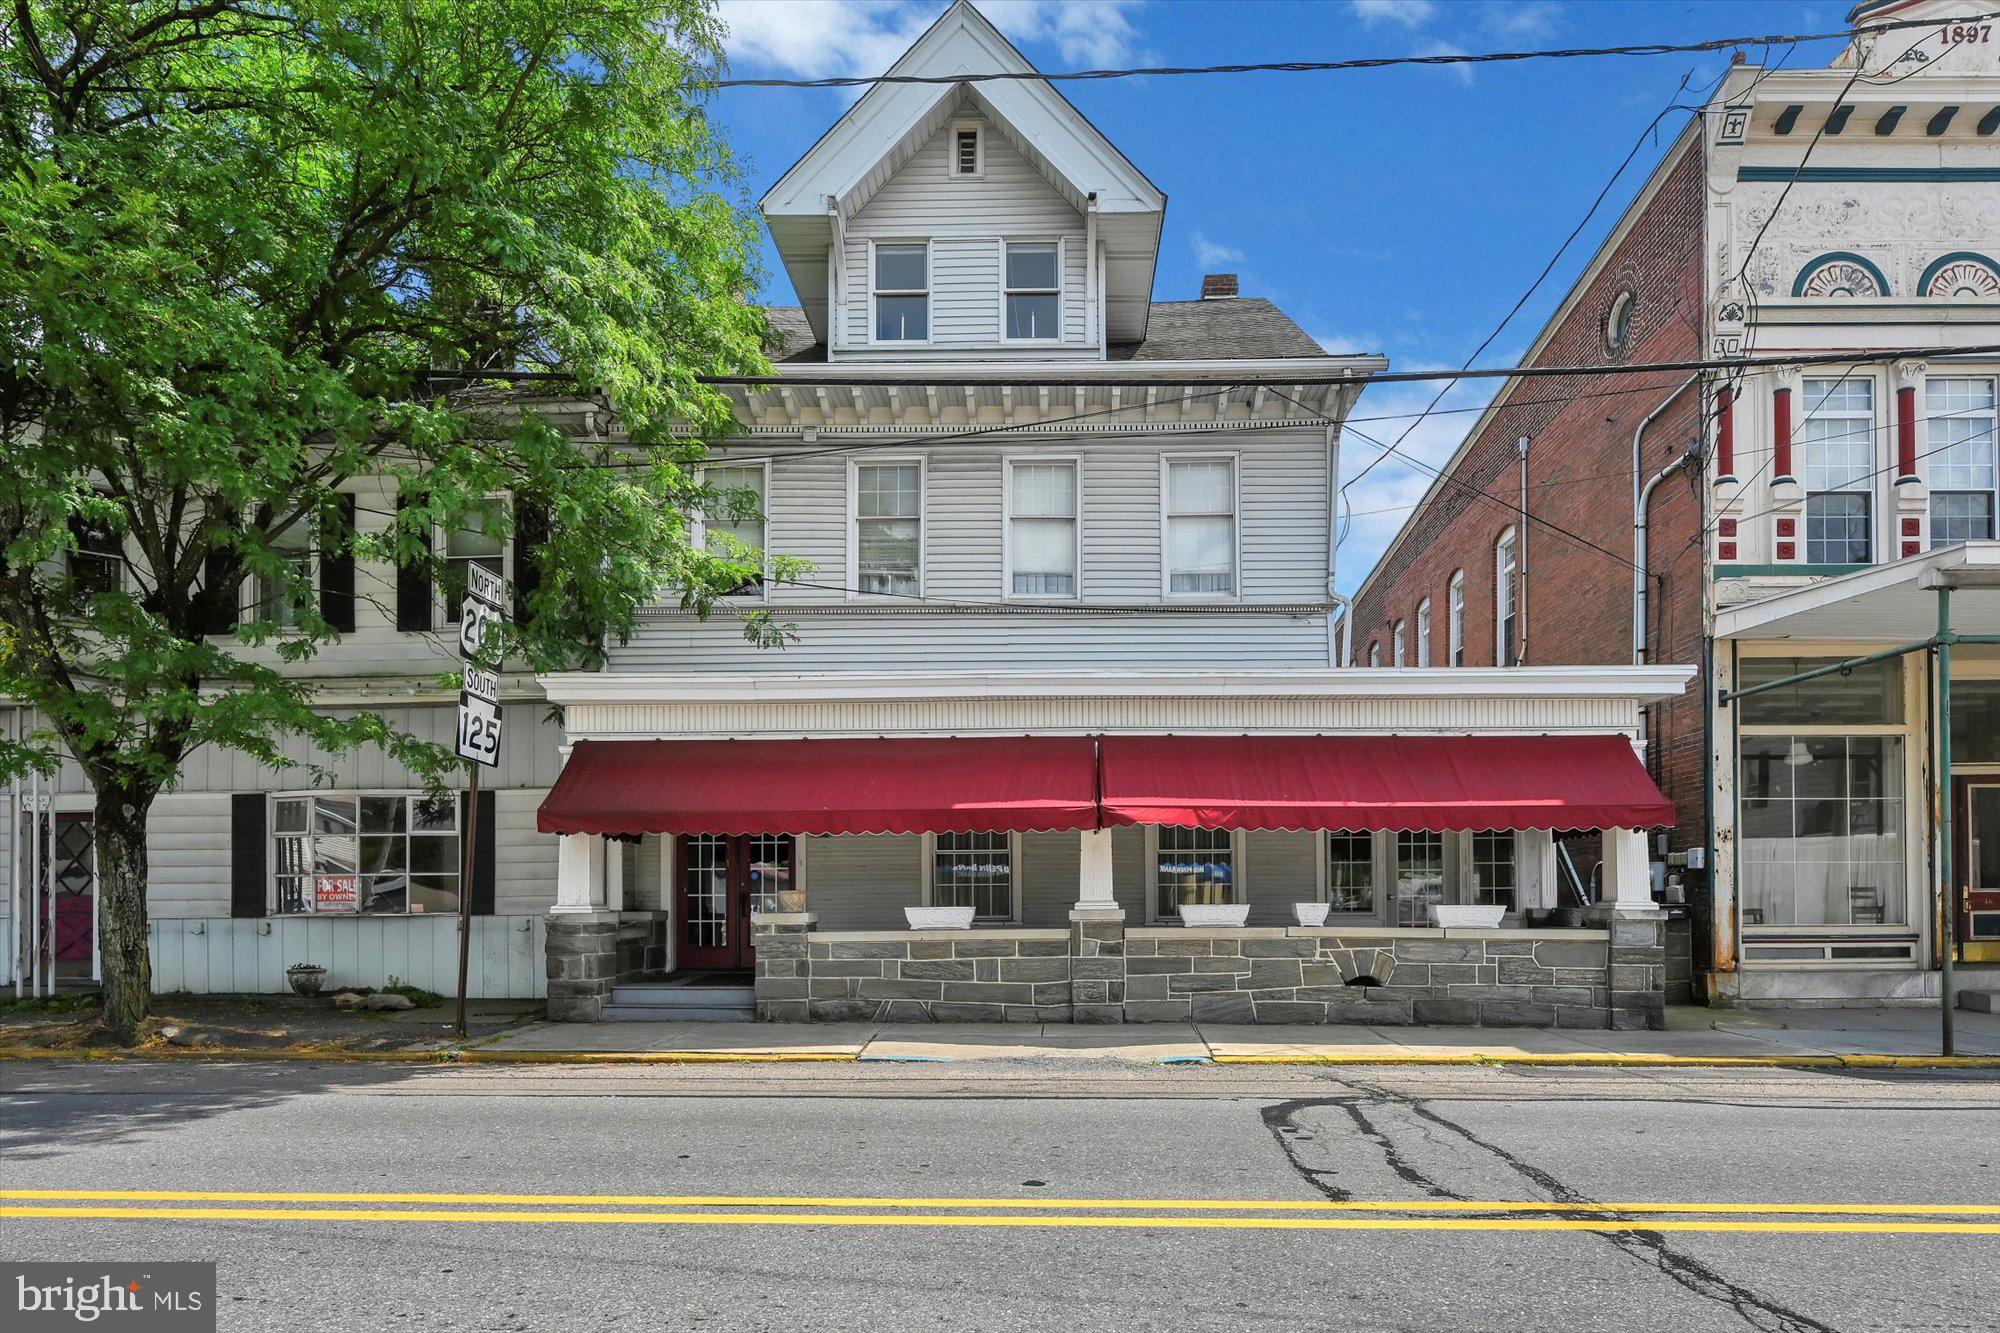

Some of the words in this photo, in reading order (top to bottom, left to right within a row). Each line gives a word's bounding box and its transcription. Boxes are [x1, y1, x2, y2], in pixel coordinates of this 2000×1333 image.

[1940, 25, 1992, 44] 1897
[471, 568, 501, 601] NORTH
[464, 608, 500, 652] 20
[466, 668, 497, 699] SOUTH
[462, 712, 497, 754] 125
[318, 879, 334, 892] FOR
